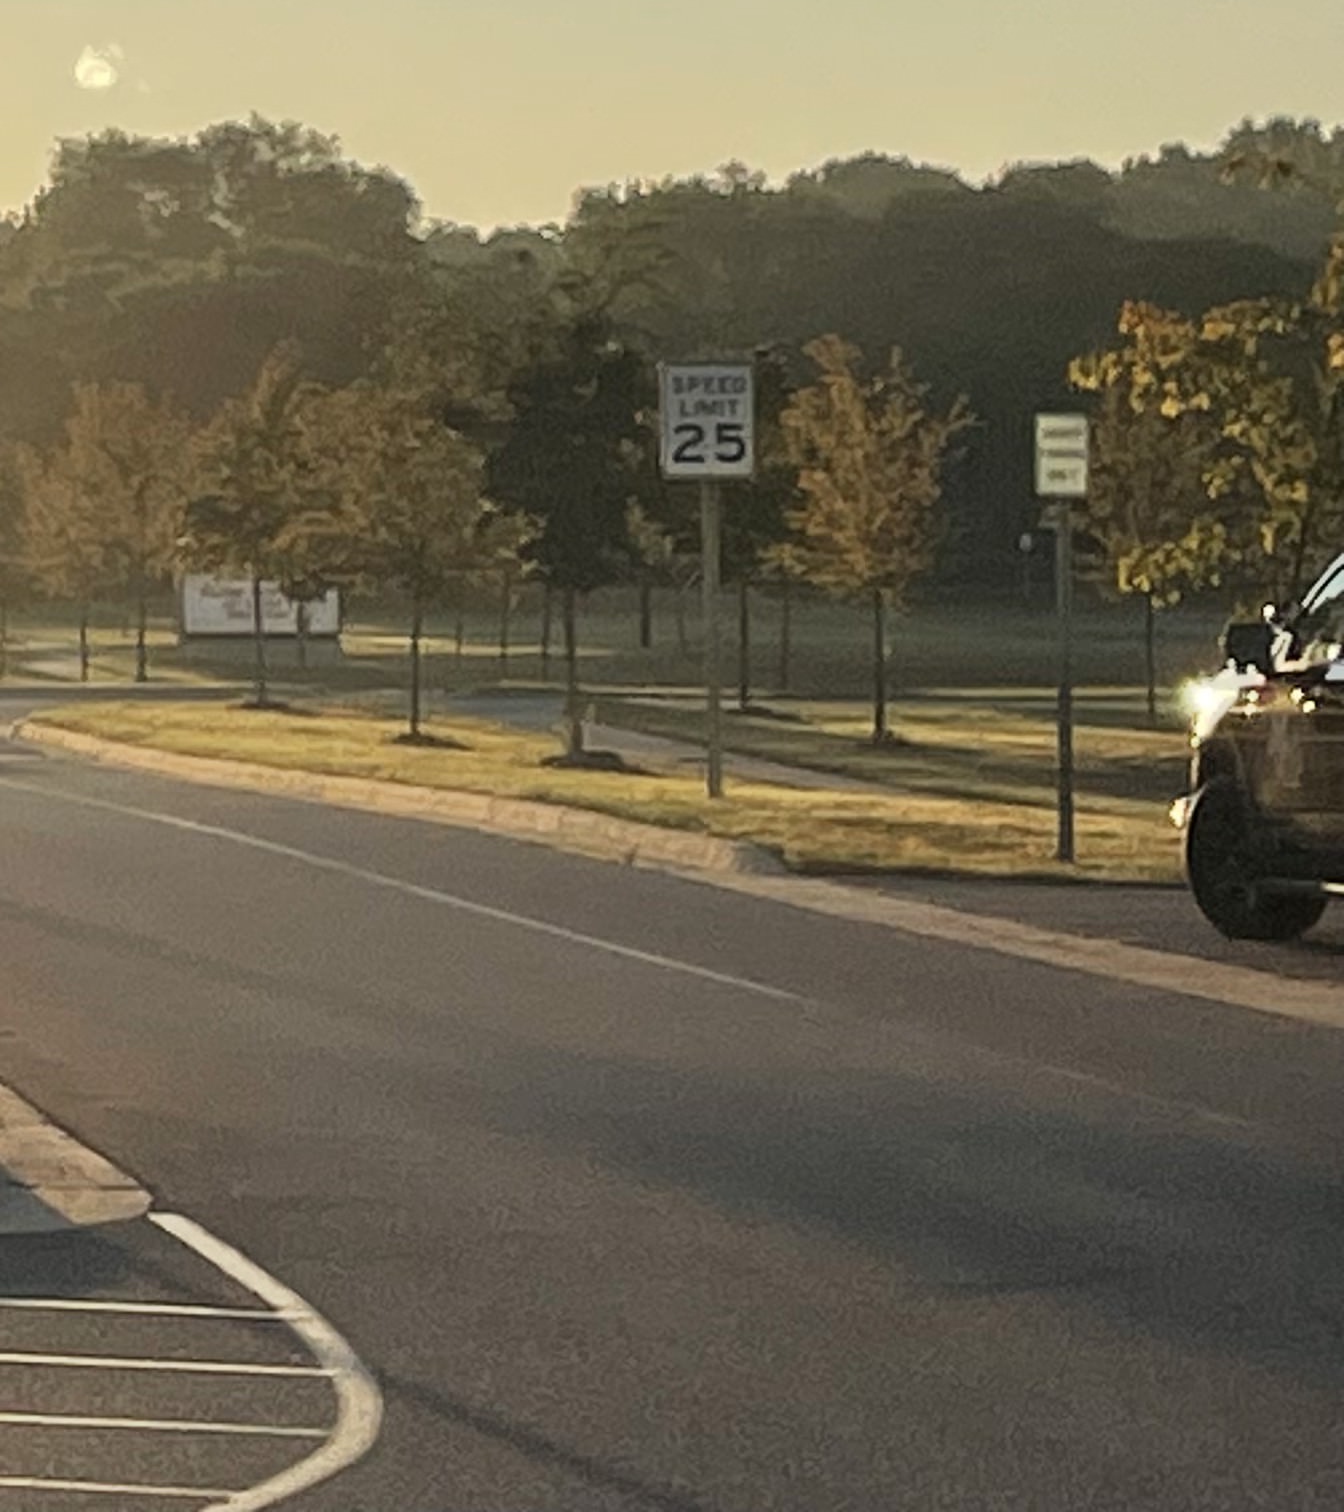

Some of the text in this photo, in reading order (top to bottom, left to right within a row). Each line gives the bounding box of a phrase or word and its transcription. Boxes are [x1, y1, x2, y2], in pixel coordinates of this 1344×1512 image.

[673, 375, 747, 395] SPEED
[679, 398, 739, 418] LIMIT
[673, 422, 745, 464] 25
